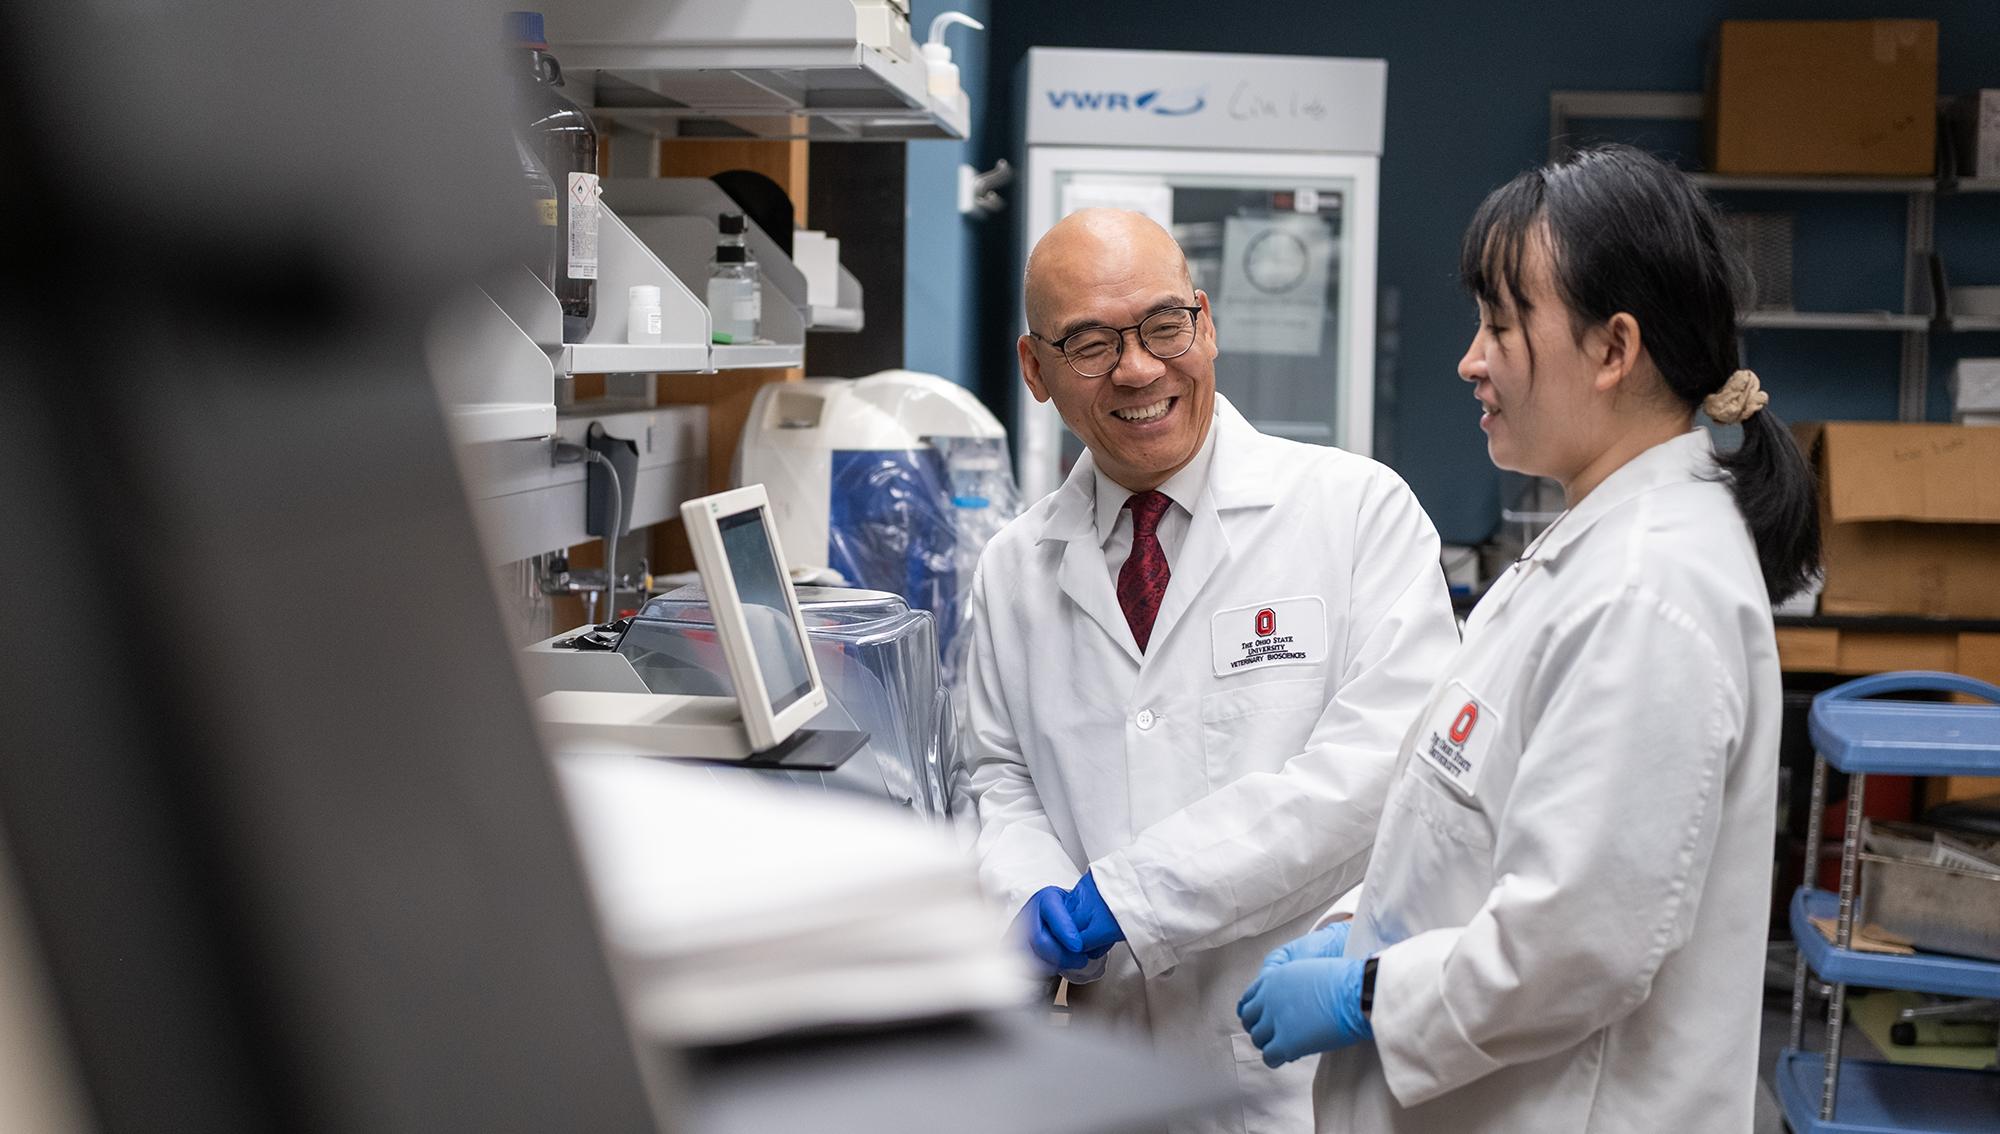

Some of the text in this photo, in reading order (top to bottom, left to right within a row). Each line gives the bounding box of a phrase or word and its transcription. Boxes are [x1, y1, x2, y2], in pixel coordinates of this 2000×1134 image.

[1047, 90, 1130, 111] VWR
[1255, 608, 1276, 637] O
[1255, 638, 1271, 647] OHIO
[1273, 636, 1293, 644] STATE
[1248, 644, 1285, 655] UNIVERSITY
[1267, 652, 1306, 660] BIOSCIENCES
[1230, 656, 1264, 668] VETERINARY
